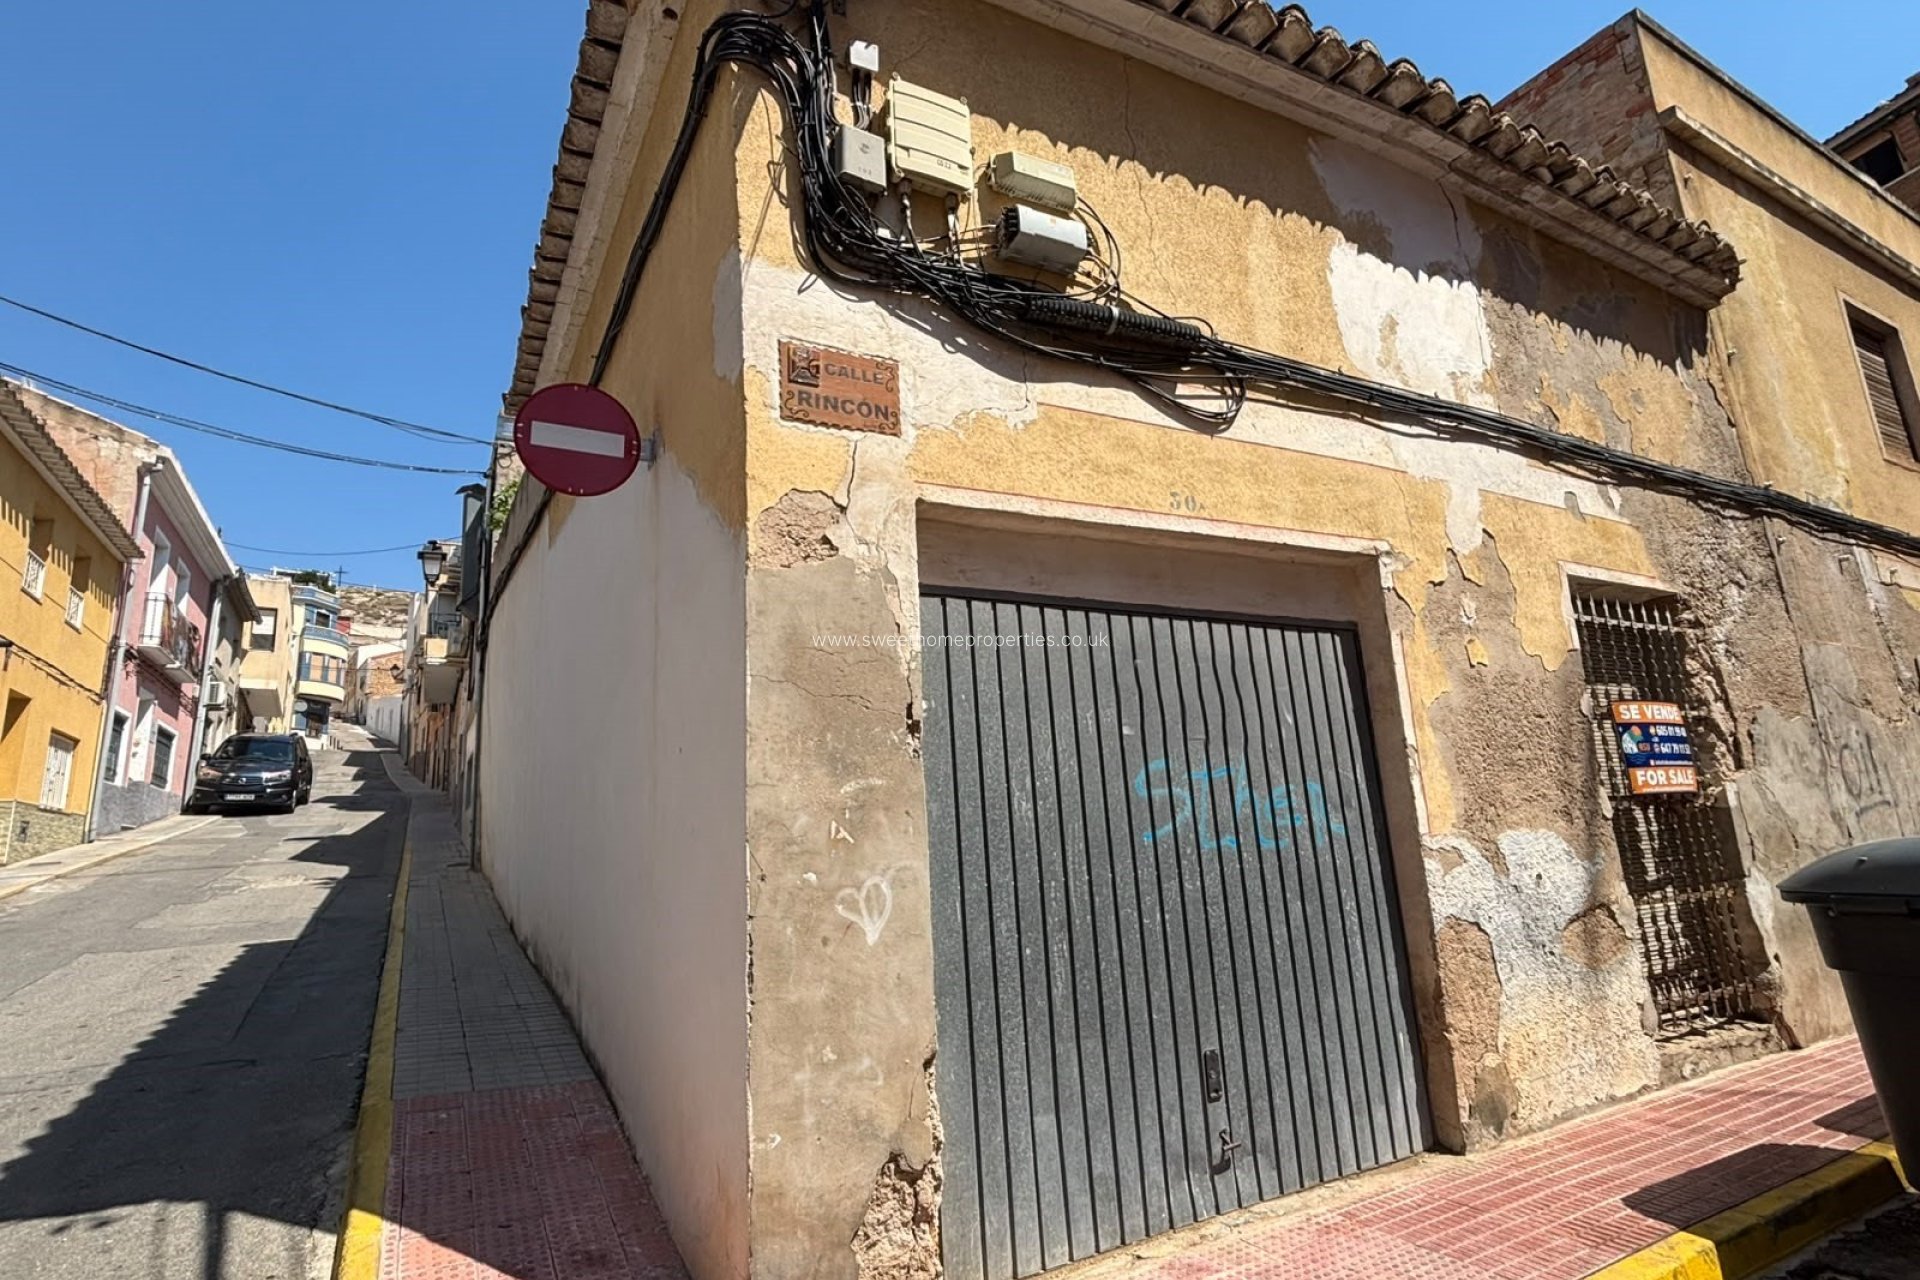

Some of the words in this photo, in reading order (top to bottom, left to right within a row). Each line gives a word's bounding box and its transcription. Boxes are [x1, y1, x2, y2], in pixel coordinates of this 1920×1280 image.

[824, 363, 885, 385] CALLE
[1619, 704, 1641, 719] SE
[1642, 704, 1681, 720] VENDE
[1636, 769, 1668, 785] FOR
[1668, 768, 1695, 785] SALE
